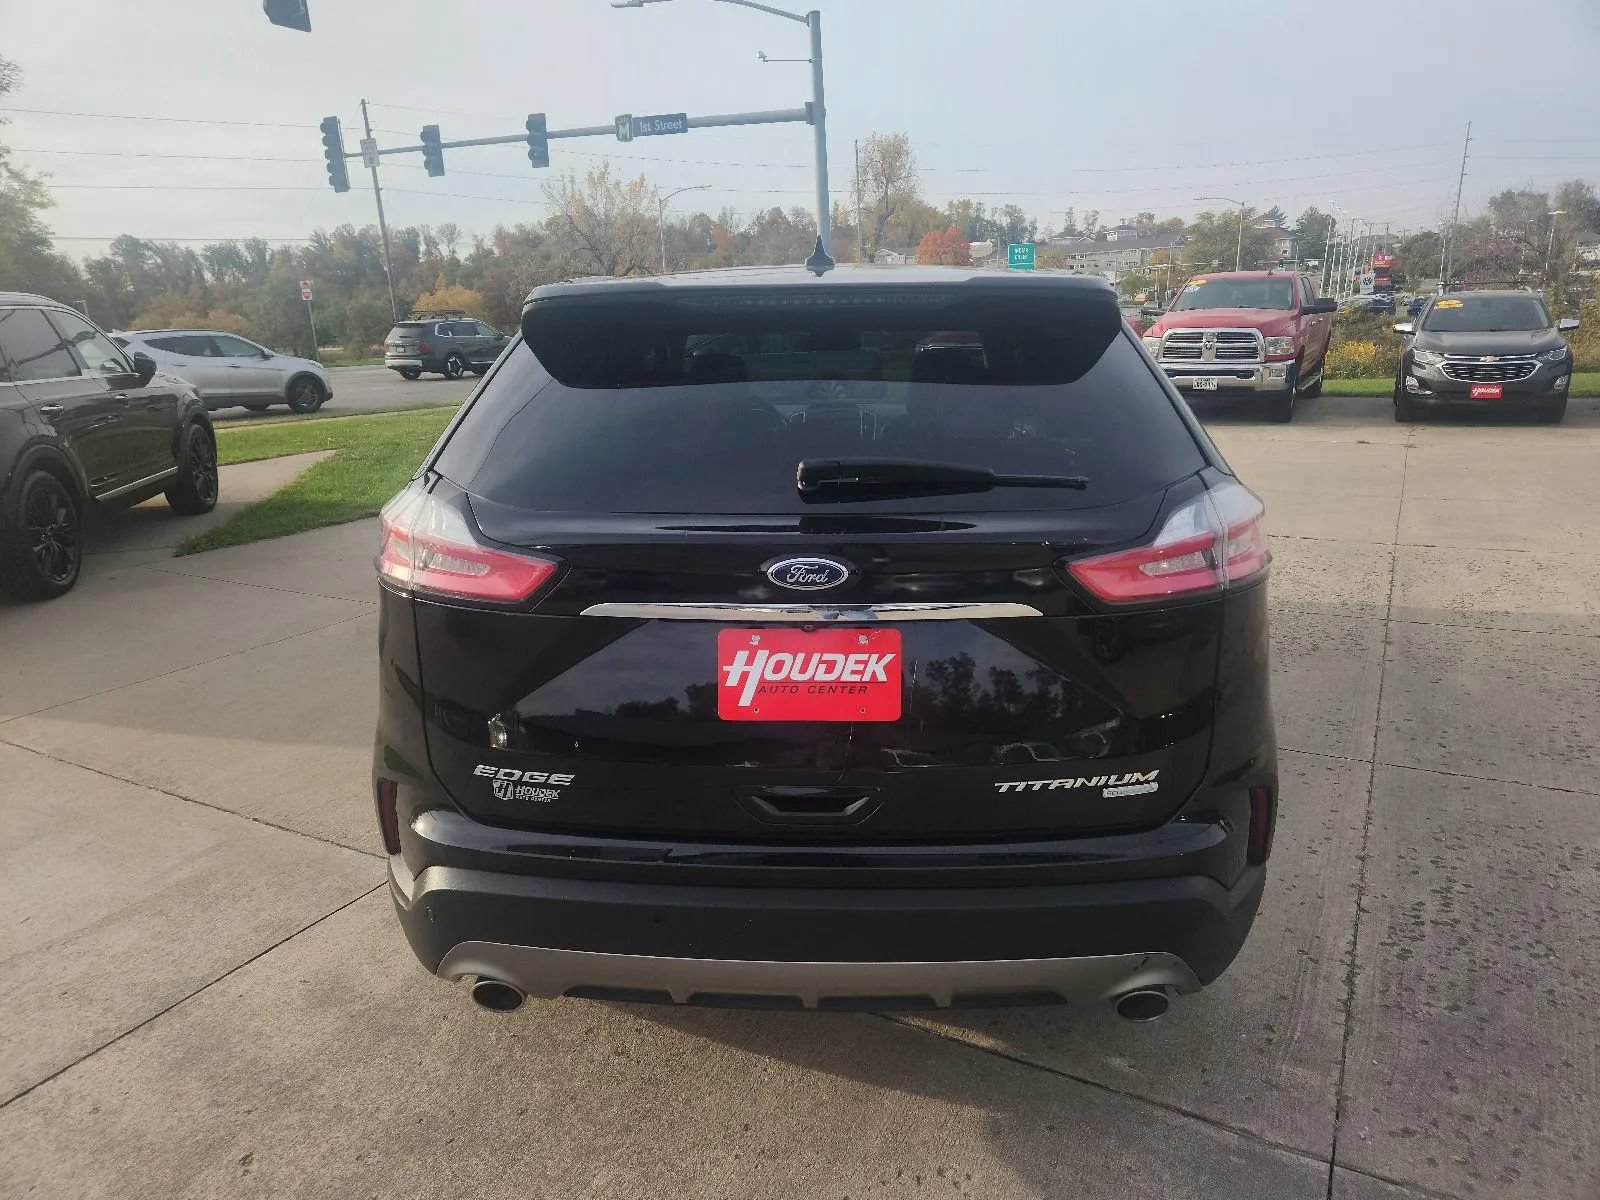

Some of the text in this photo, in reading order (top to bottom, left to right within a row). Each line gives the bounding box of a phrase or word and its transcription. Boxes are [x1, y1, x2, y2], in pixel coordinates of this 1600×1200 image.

[640, 119, 683, 133] 1st Street
[786, 564, 830, 583] Ford
[722, 649, 897, 707] HOUDEK
[758, 685, 868, 694] AUTO CENTER
[473, 764, 576, 786] EDGE
[994, 769, 1160, 793] TITANIUM
[515, 785, 560, 797] HOUDEK
